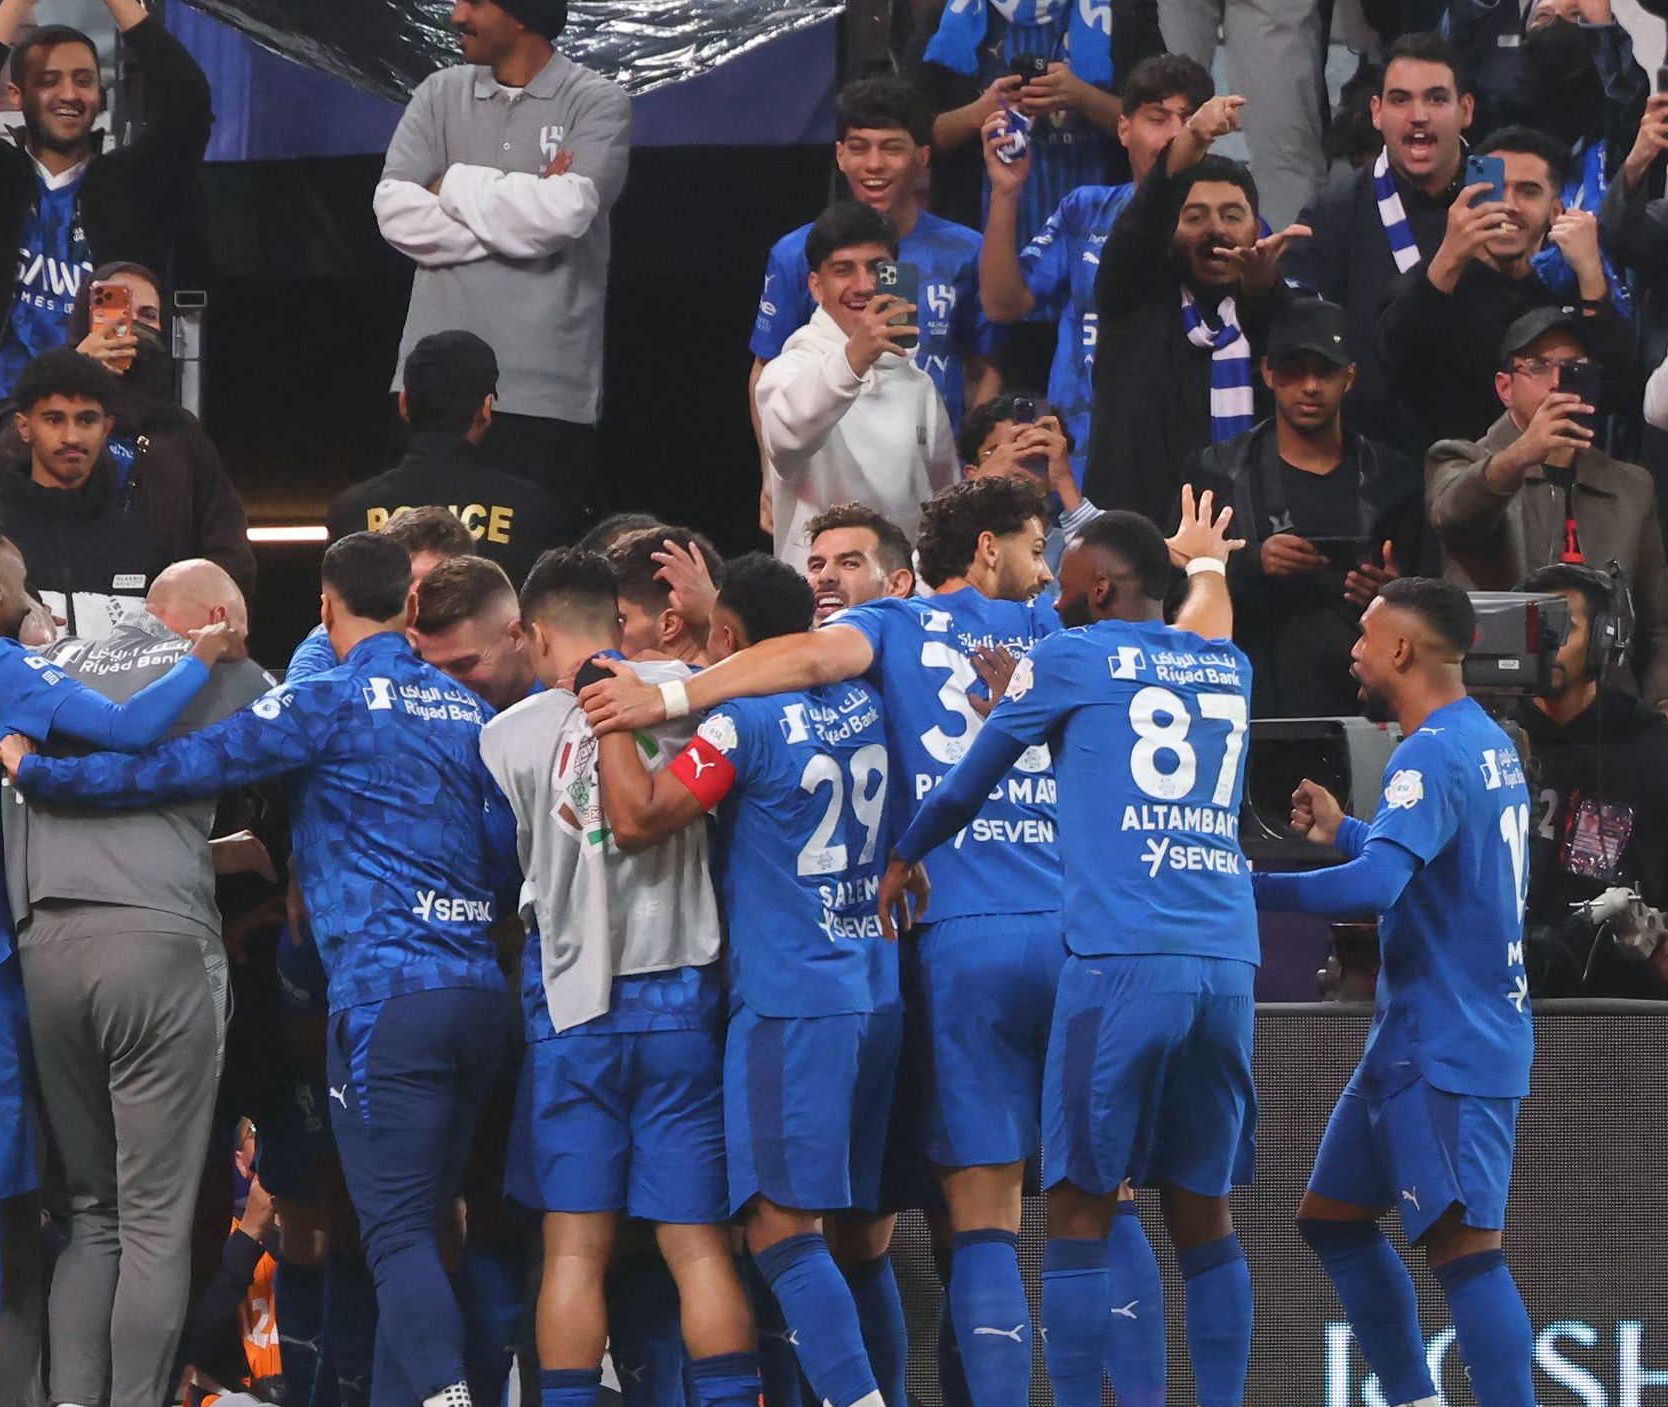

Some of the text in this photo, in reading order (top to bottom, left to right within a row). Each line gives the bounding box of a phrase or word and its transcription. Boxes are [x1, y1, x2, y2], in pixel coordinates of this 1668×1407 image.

[78, 651, 185, 676] Riyad Bank
[1155, 665, 1242, 688] Riyad Bank
[1199, 655, 1237, 679] بنك
[403, 697, 483, 726] Riyad Bank
[1128, 686, 1248, 808] 87
[796, 742, 890, 877] 29
